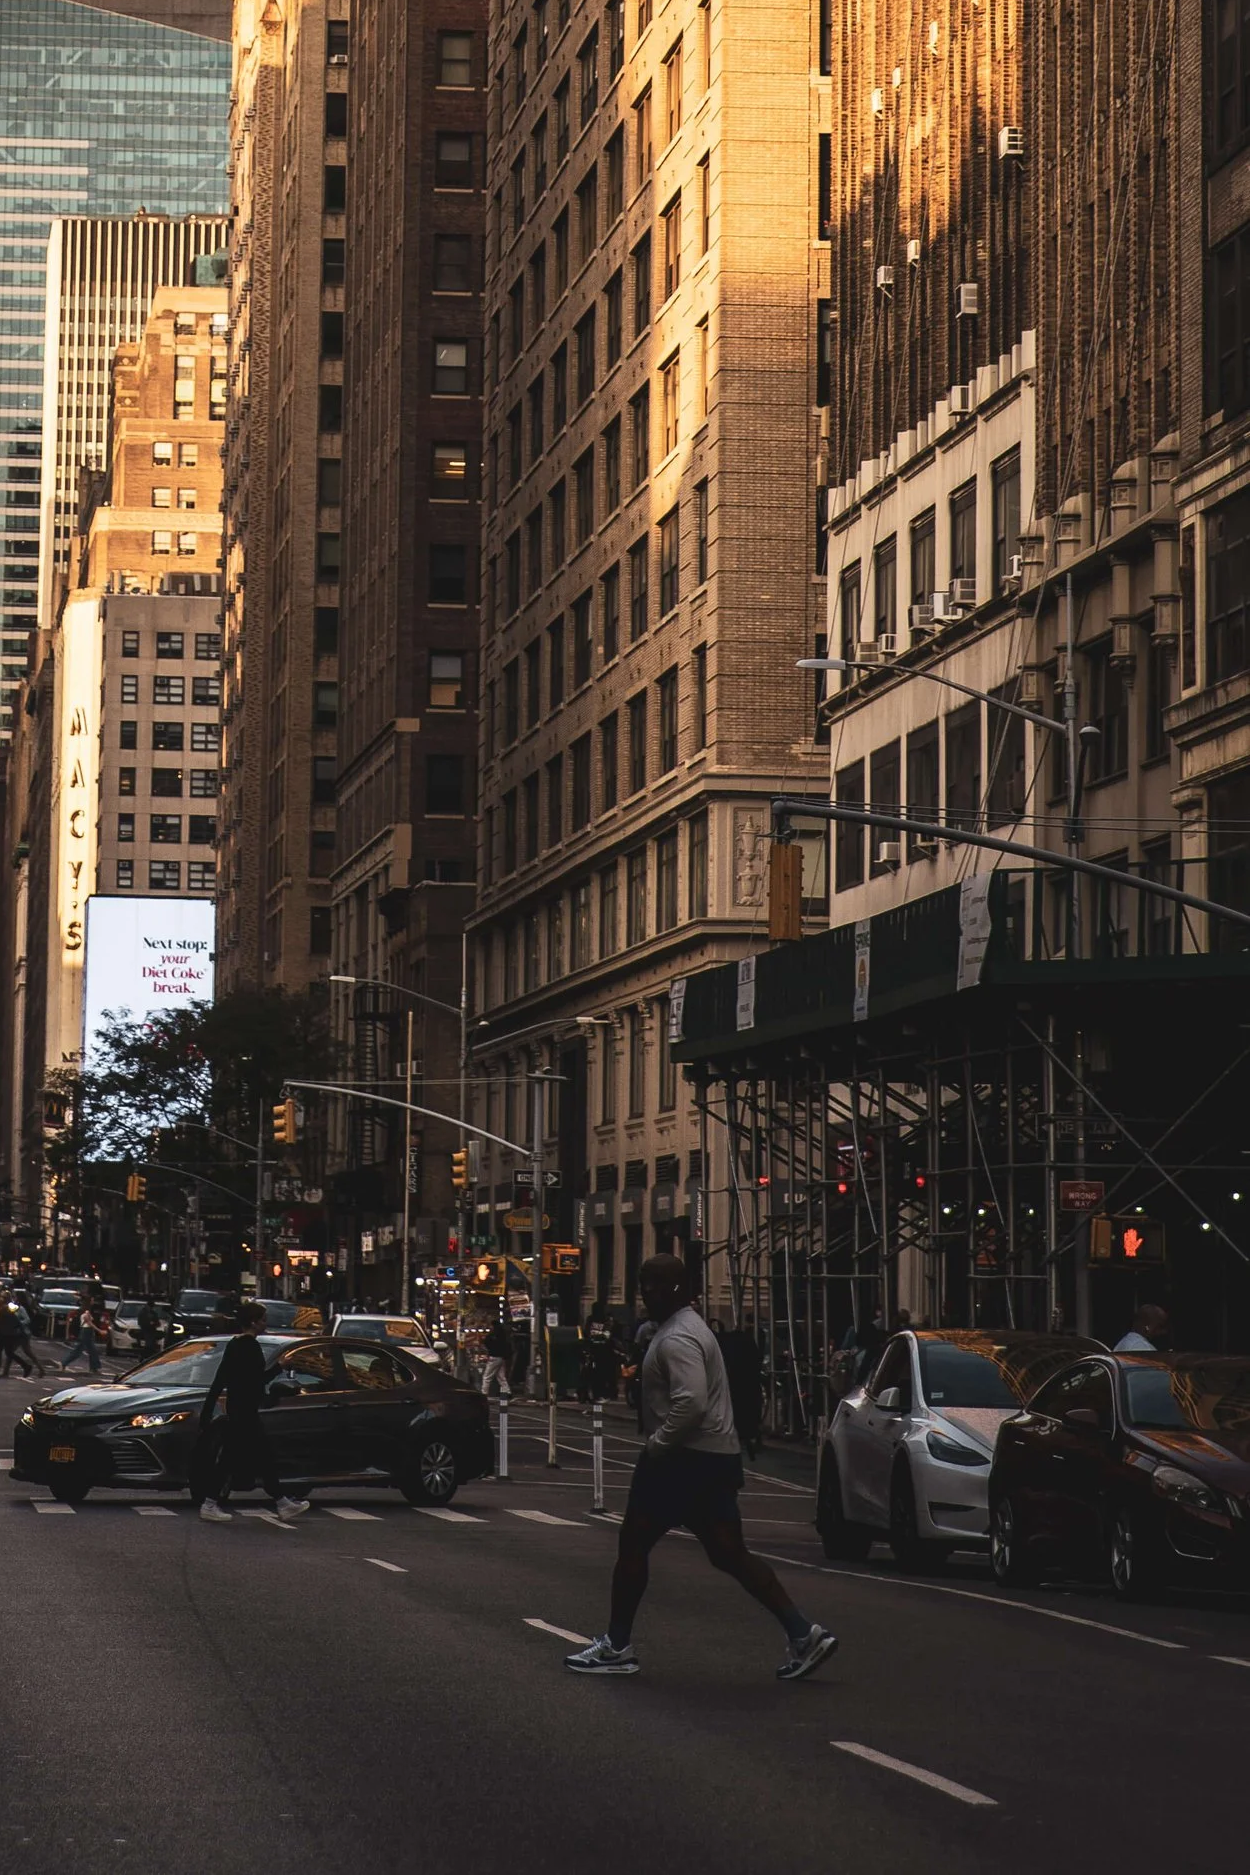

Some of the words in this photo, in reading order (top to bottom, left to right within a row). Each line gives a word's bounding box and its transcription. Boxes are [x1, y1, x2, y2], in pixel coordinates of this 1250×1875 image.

[143, 937, 172, 949] Next
[176, 940, 207, 953] stop:
[159, 955, 191, 967] your
[142, 966, 167, 978] Diet
[153, 981, 196, 993] break.
[1068, 1192, 1097, 1201] WRONG
[1074, 1200, 1091, 1208] WAY
